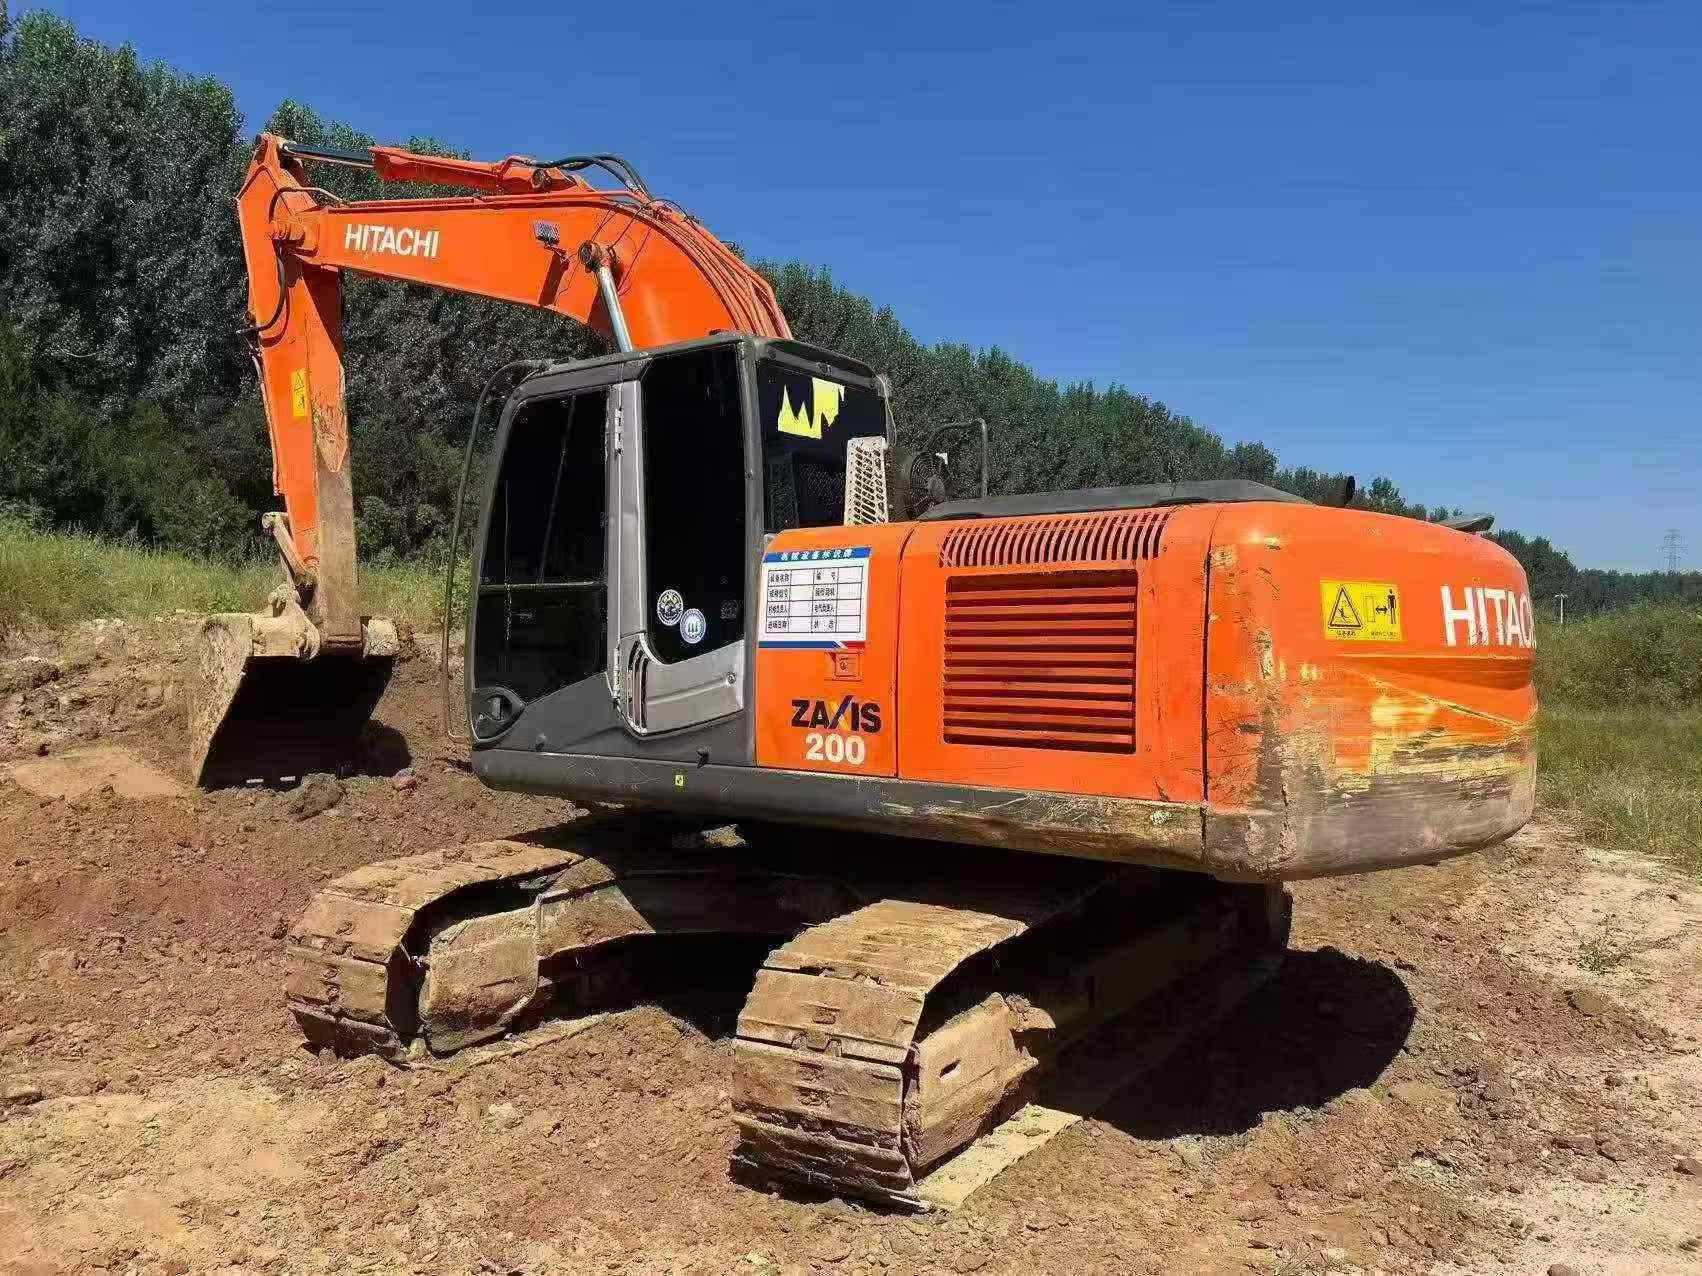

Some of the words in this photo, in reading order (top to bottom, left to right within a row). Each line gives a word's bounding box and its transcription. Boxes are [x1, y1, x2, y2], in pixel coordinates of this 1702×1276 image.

[344, 223, 441, 257] HITACHI
[791, 694, 882, 733] ZAXIS
[805, 732, 865, 765] 200
